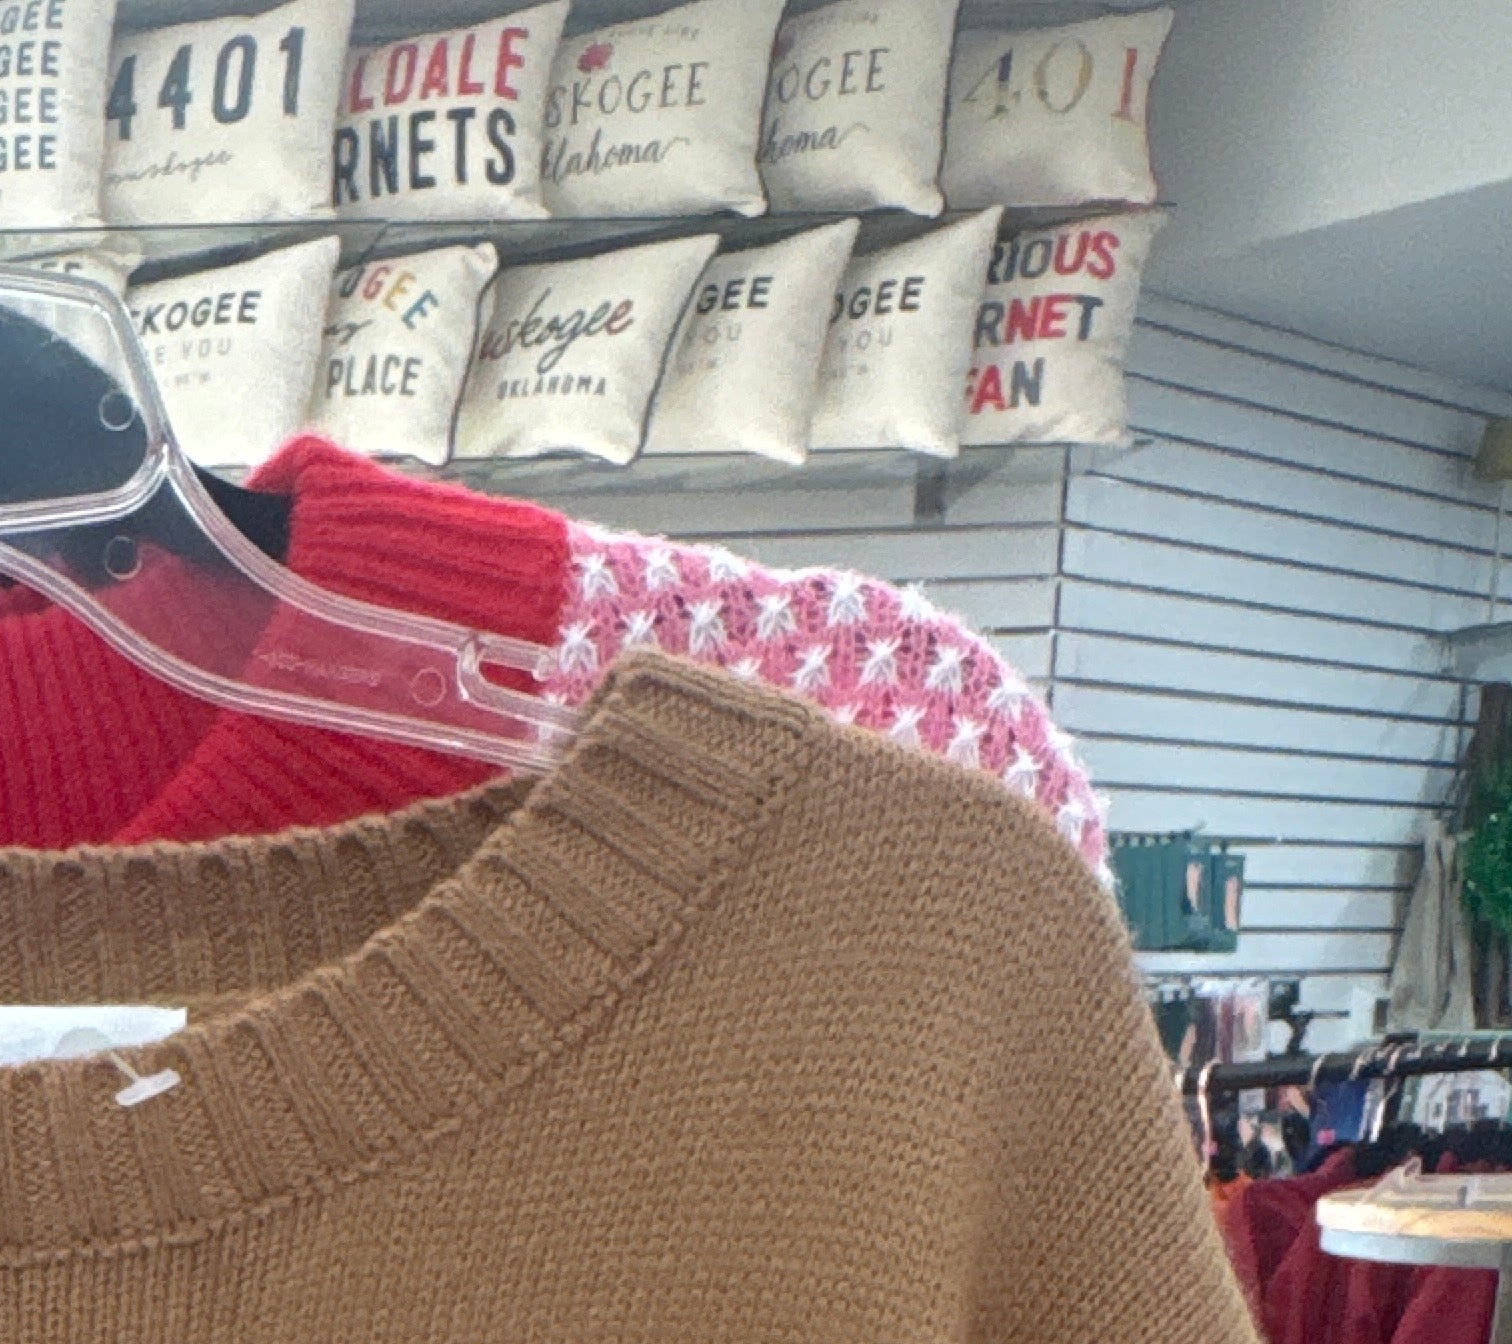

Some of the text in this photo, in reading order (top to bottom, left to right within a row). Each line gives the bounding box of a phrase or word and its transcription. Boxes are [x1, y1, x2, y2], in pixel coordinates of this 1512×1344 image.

[105, 26, 305, 141] 4401
[130, 290, 262, 336] KOGEE
[326, 353, 423, 399] PLACE
